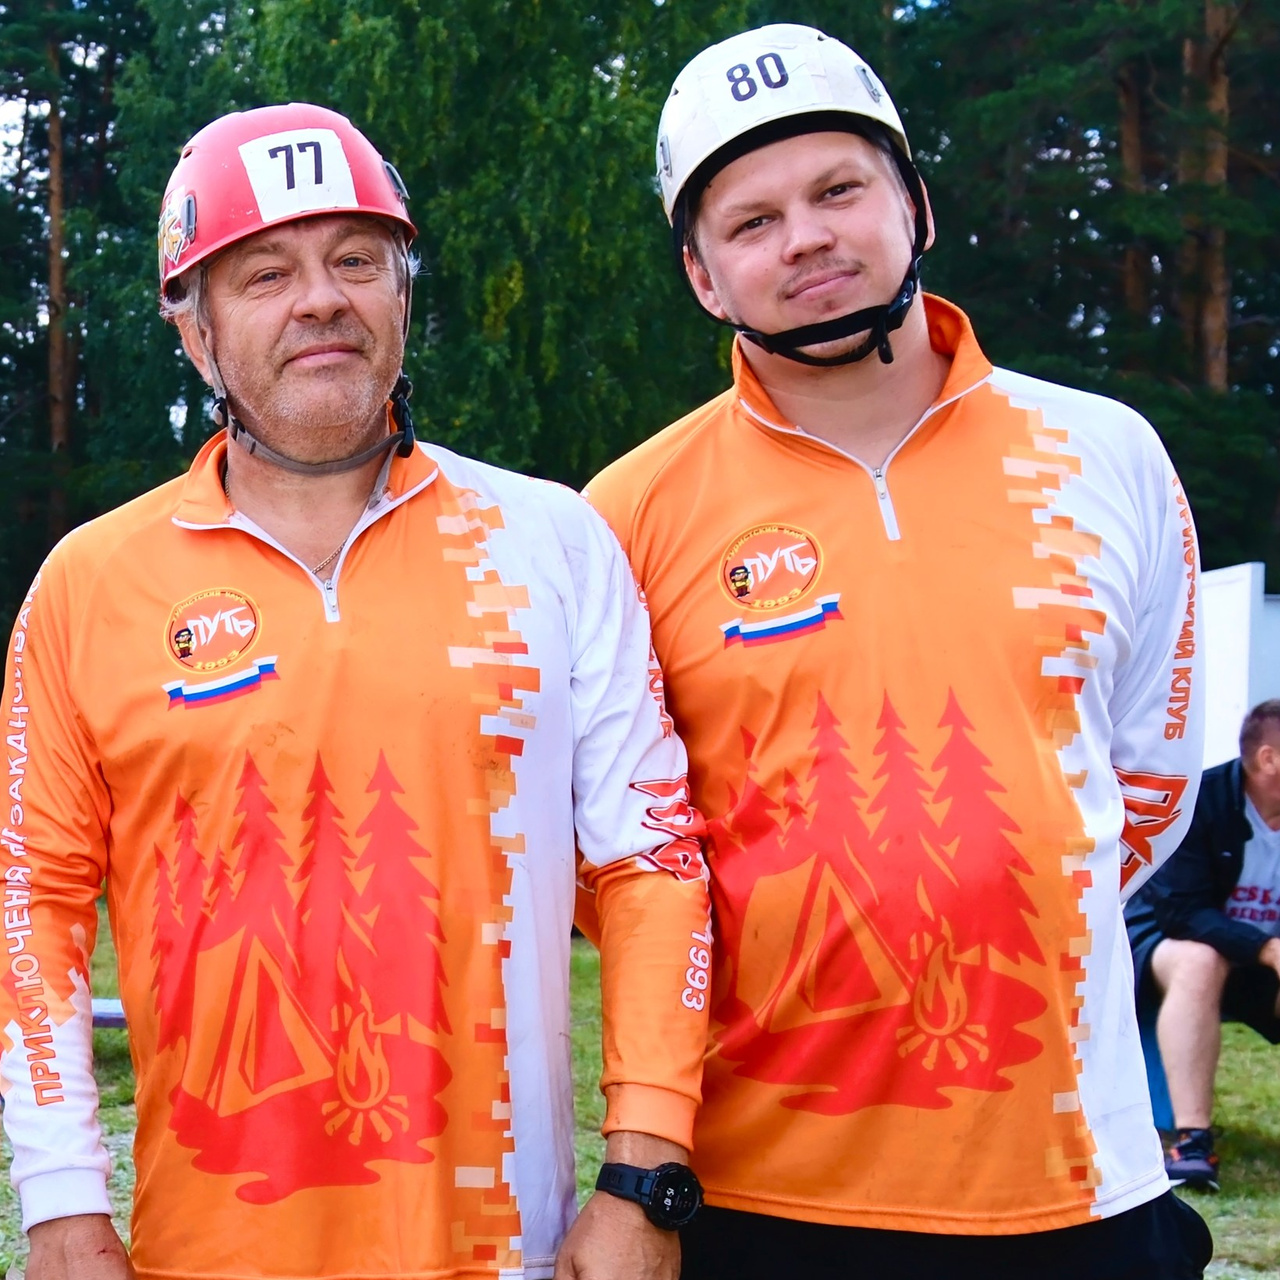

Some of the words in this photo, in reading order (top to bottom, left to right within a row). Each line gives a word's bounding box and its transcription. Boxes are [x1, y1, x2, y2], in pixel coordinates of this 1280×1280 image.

[726, 52, 789, 102] 80
[268, 141, 323, 190] 77
[743, 542, 817, 590] ПУТЬ
[751, 588, 802, 608] 1993
[186, 606, 256, 651] ПУТЬ
[194, 650, 240, 670] 1993
[1163, 667, 1192, 741] КЛУБ
[681, 930, 712, 1013] 1993
